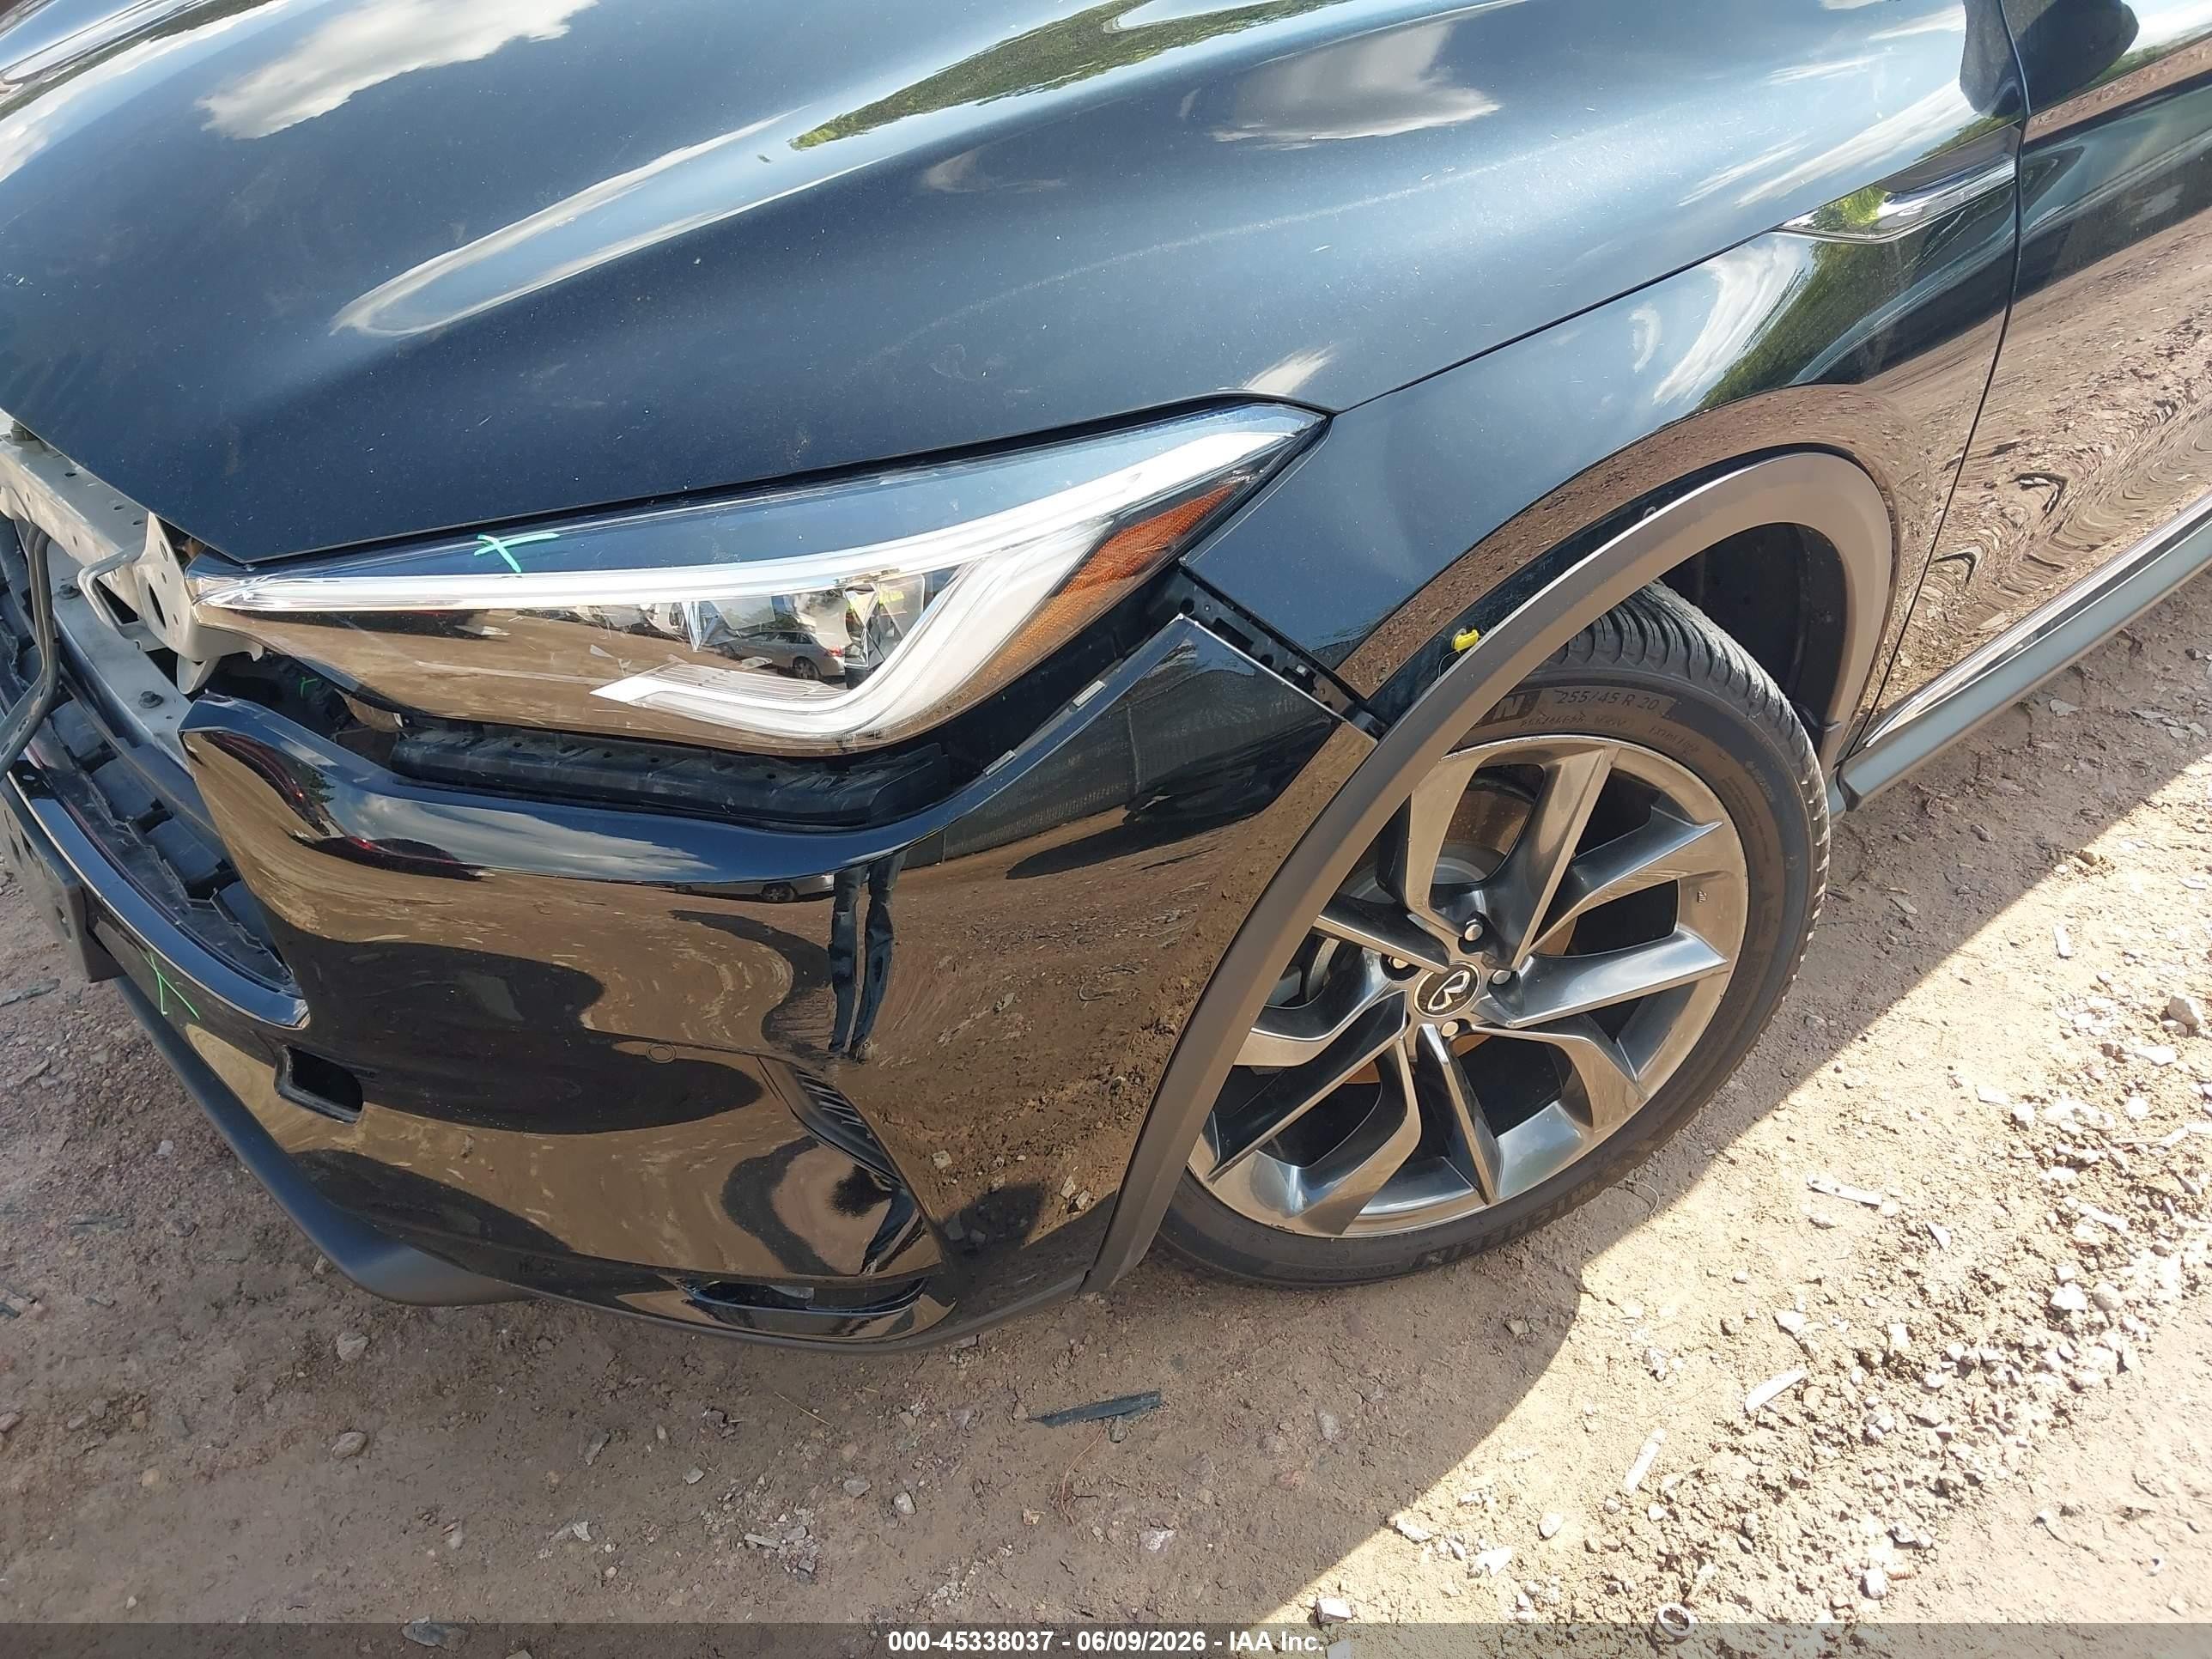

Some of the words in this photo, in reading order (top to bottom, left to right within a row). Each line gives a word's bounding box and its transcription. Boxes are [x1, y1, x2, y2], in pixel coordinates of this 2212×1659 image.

[1558, 690, 1620, 704] 255/45
[1621, 694, 1636, 706] R
[1638, 696, 1660, 710] 20
